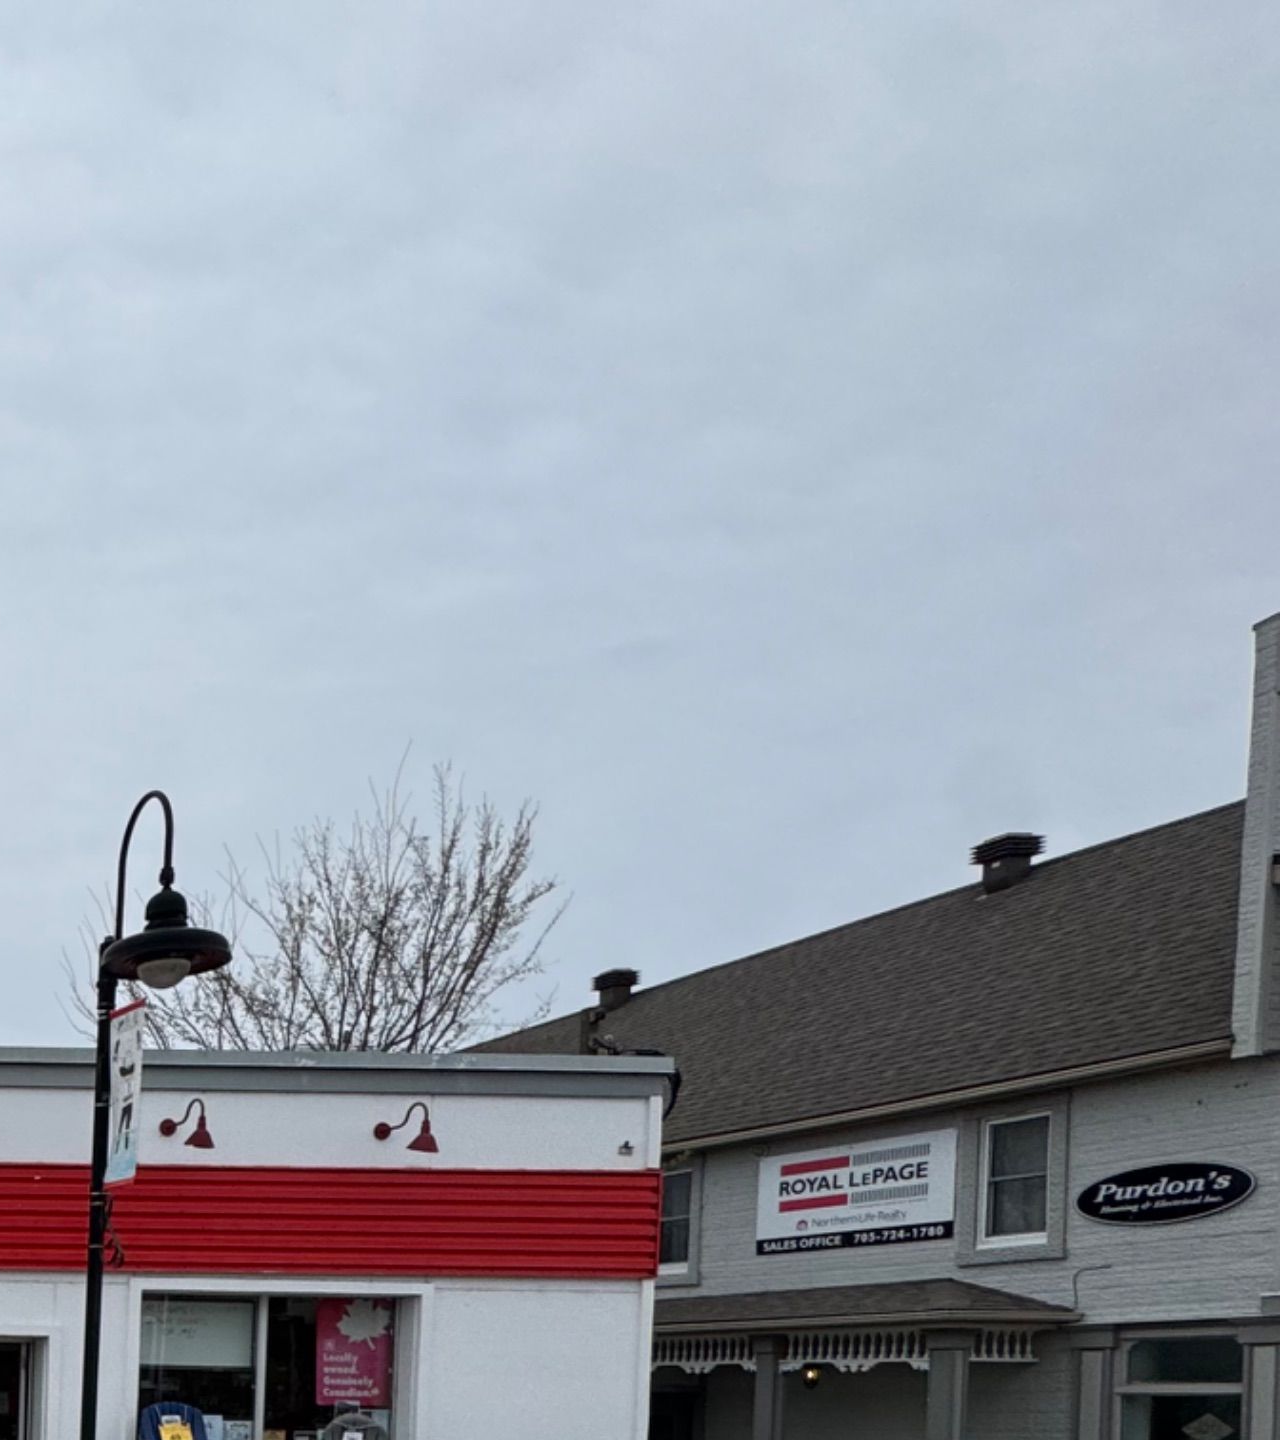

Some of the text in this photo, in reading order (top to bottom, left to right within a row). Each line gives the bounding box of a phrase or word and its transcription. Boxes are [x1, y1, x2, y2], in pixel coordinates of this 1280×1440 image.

[779, 1174, 844, 1197] ROYAL
[1093, 1170, 1232, 1203] Purdon's
[810, 1215, 858, 1228] Northern
[877, 1209, 907, 1223] Realty
[763, 1238, 797, 1252] SALES
[799, 1235, 841, 1250] OFFICE
